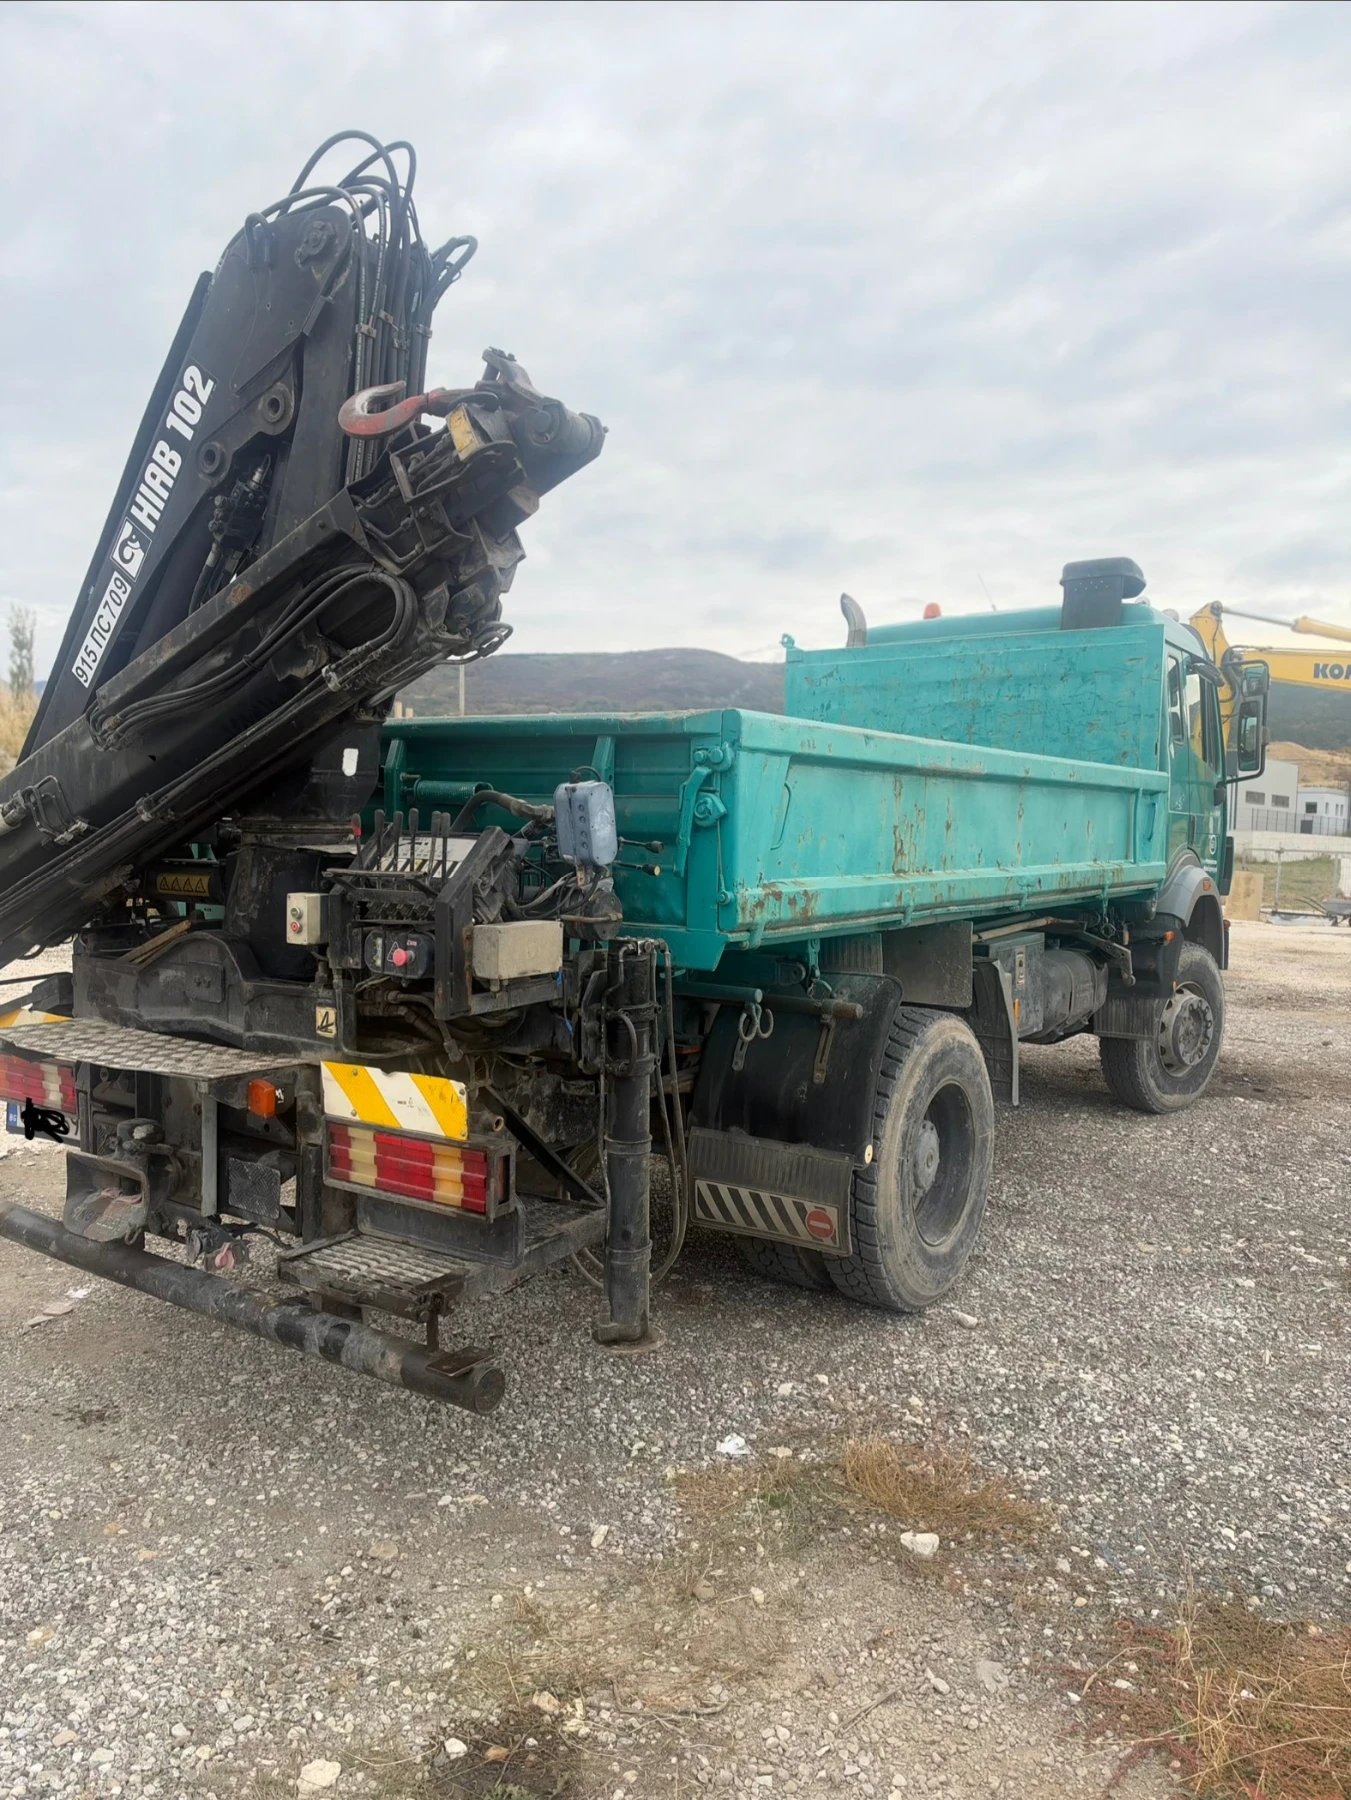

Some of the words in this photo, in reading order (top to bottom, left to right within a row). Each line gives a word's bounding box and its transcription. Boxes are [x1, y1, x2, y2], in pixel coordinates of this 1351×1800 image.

[130, 440, 182, 533] HIAB
[166, 365, 215, 441] 102
[75, 644, 98, 684] 915
